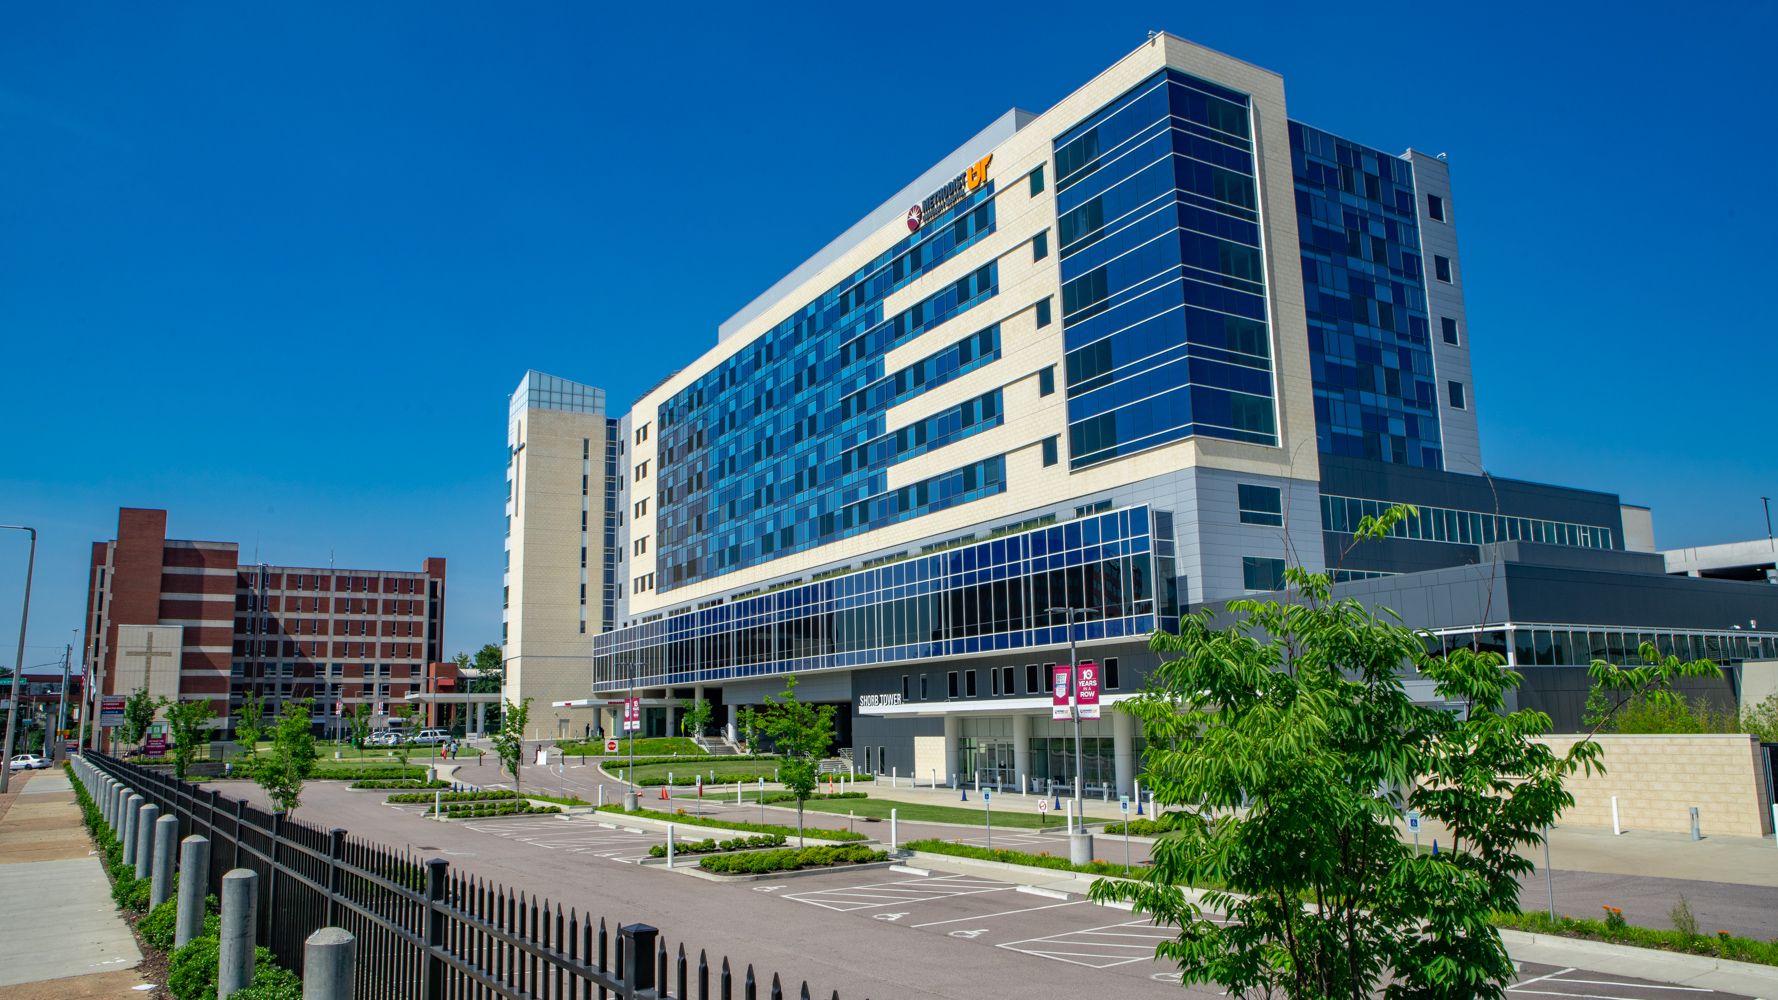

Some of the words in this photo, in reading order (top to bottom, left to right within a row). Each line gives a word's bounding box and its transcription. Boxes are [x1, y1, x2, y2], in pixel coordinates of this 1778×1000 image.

[966, 153, 992, 190] UT
[922, 172, 966, 212] METHODIST
[1082, 669, 1093, 680] 10
[859, 695, 879, 707] SHORB
[879, 693, 902, 706] TOWER
